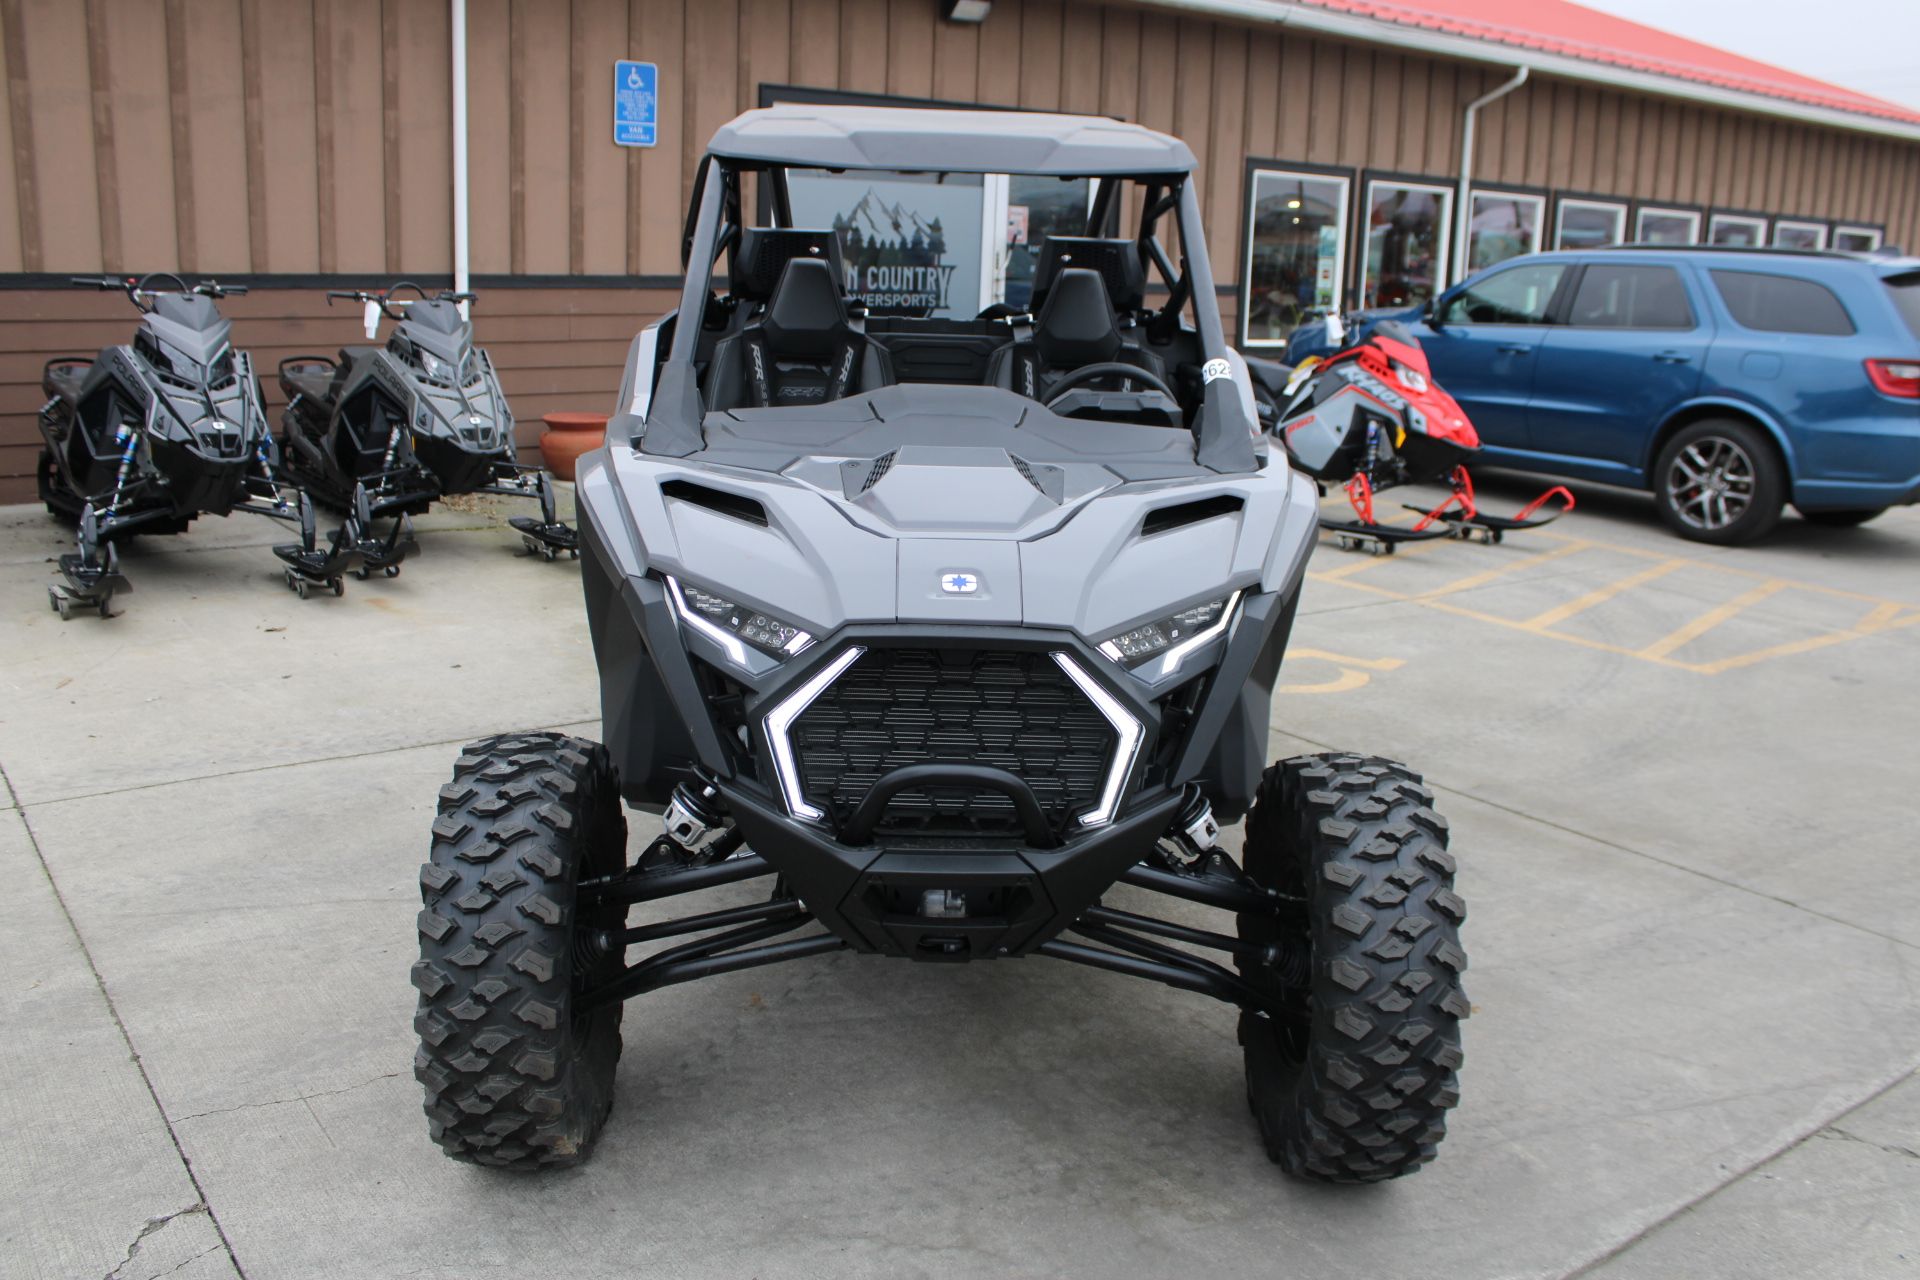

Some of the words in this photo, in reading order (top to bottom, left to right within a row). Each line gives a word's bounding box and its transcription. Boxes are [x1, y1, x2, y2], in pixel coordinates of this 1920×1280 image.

[867, 265, 955, 309] COUNTRY
[113, 355, 148, 401] POLARIS
[372, 358, 409, 401] POLARIS
